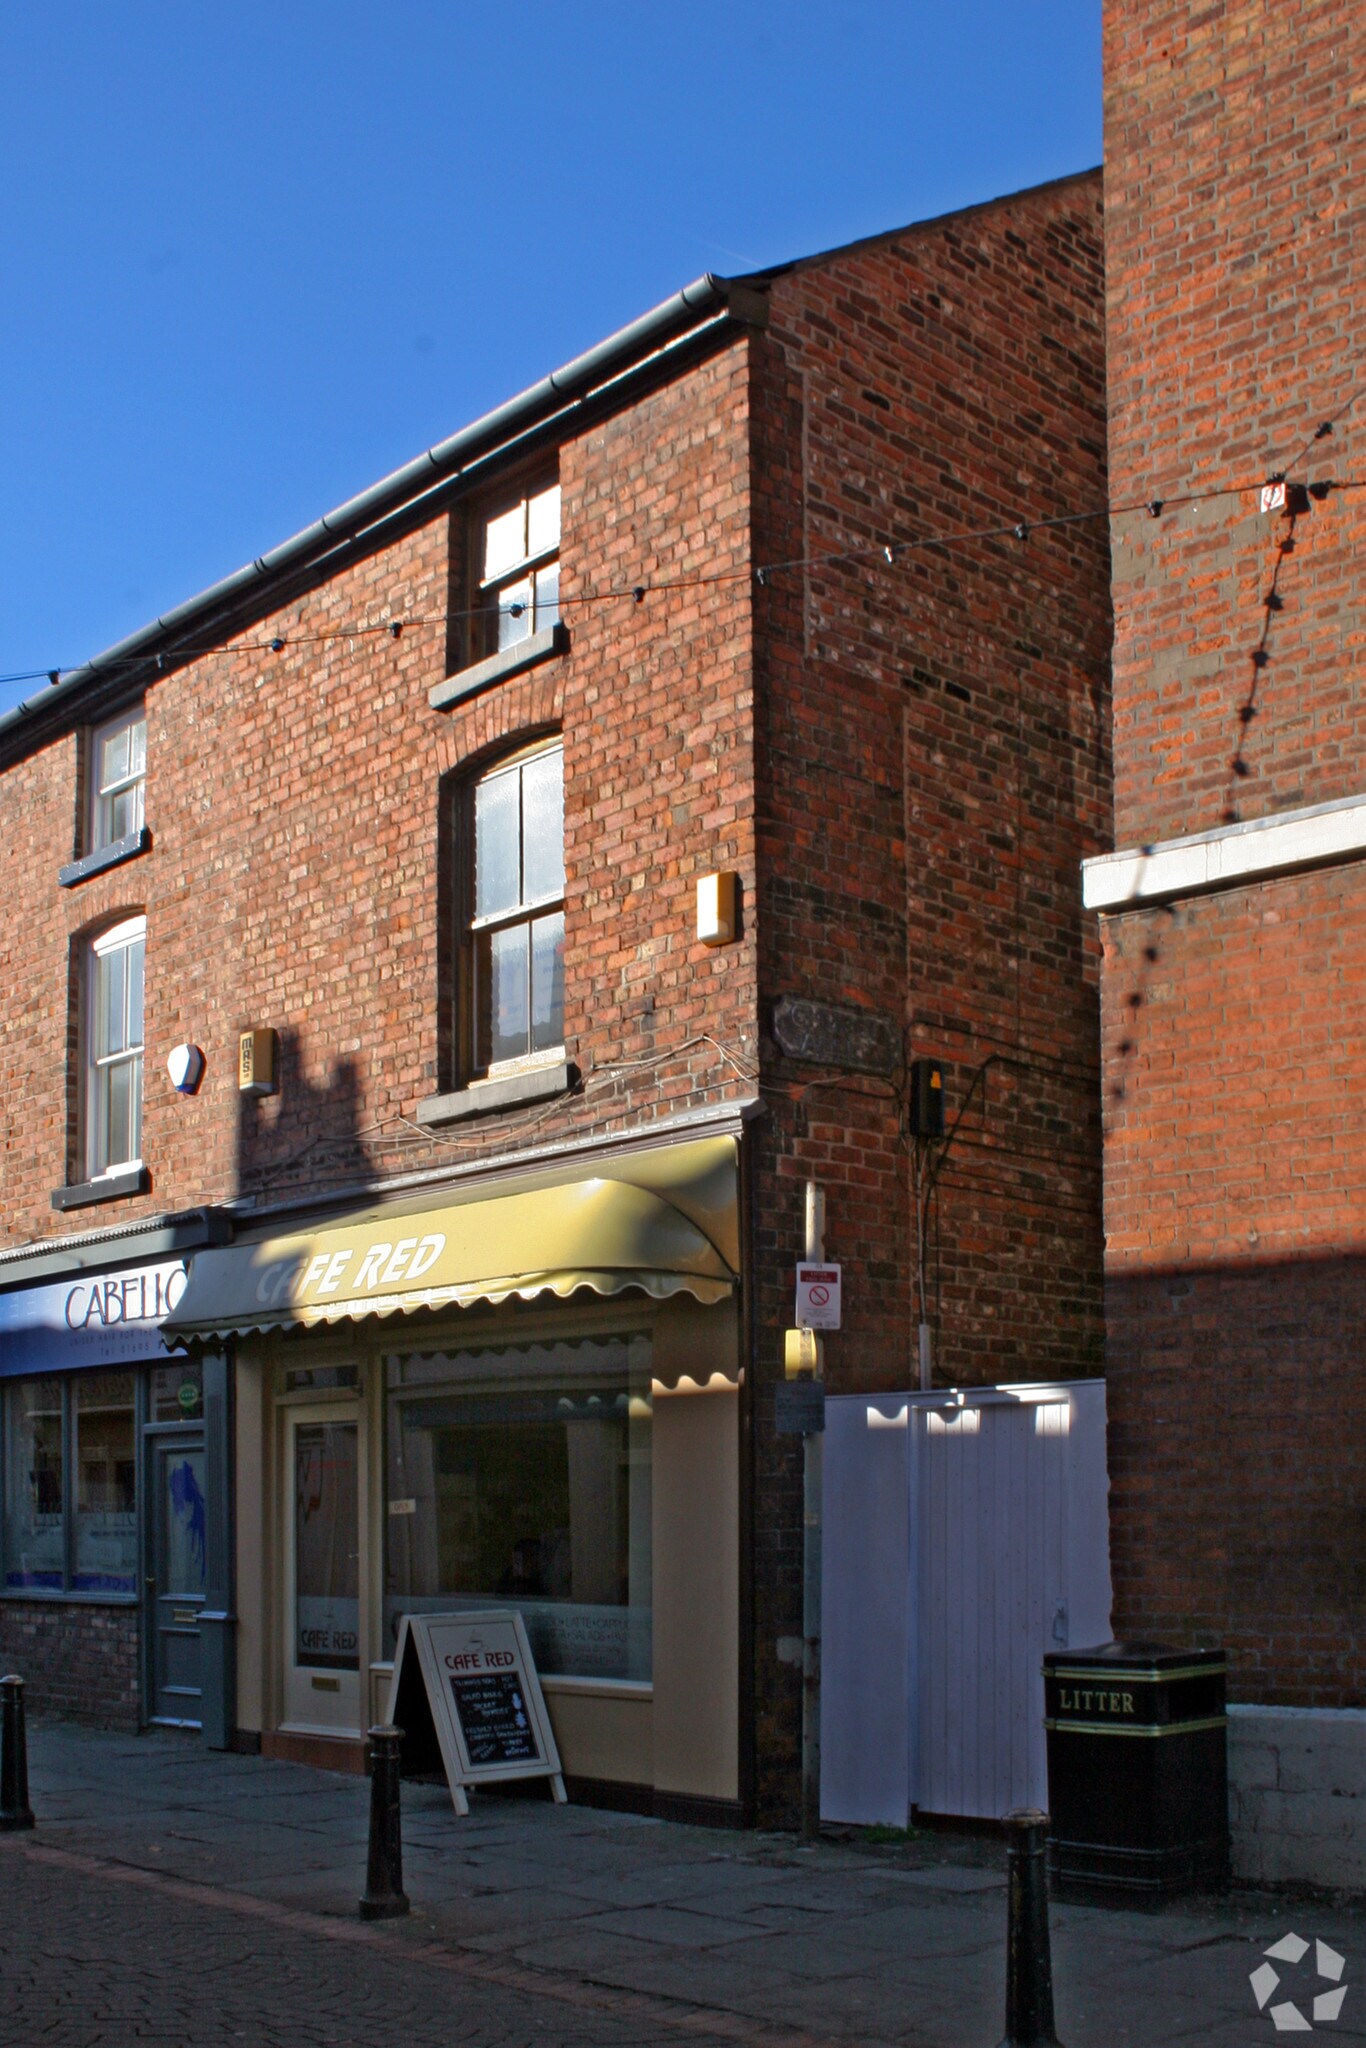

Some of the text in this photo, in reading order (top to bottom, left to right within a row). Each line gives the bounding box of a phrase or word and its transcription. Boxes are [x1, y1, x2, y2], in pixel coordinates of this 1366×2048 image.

[256, 1233, 447, 1304] CAFE RED
[301, 1629, 357, 1649] CAFE RED
[444, 1651, 514, 1671] CAFE RED
[1060, 1688, 1135, 1713] LITTER
